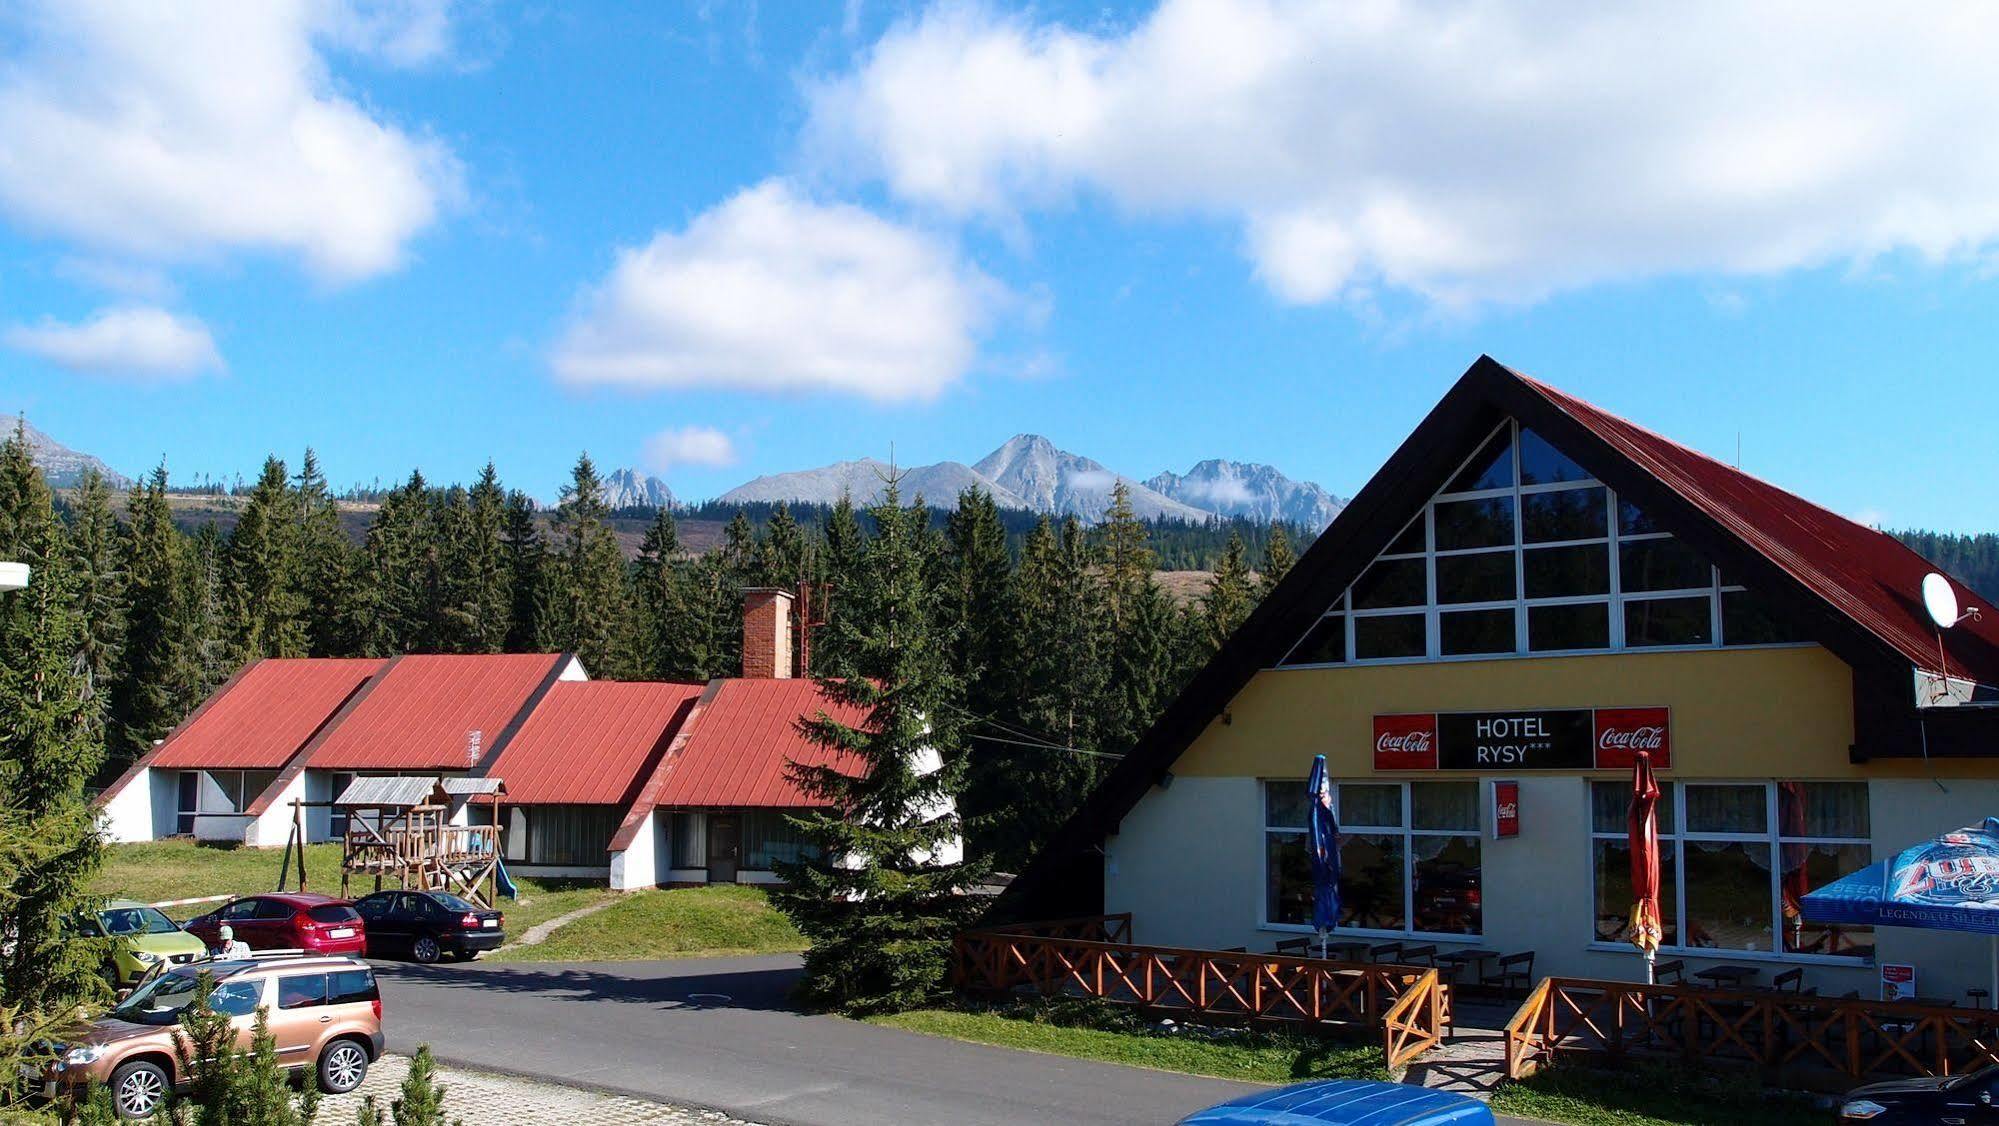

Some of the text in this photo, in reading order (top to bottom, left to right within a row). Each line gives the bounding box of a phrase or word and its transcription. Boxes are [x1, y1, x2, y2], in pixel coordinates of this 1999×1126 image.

[1476, 717, 1550, 738] HOTEL
[1600, 726, 1664, 749] Coca-Cola
[1376, 731, 1432, 752] Coca-Cola
[1477, 745, 1527, 763] RYSY
